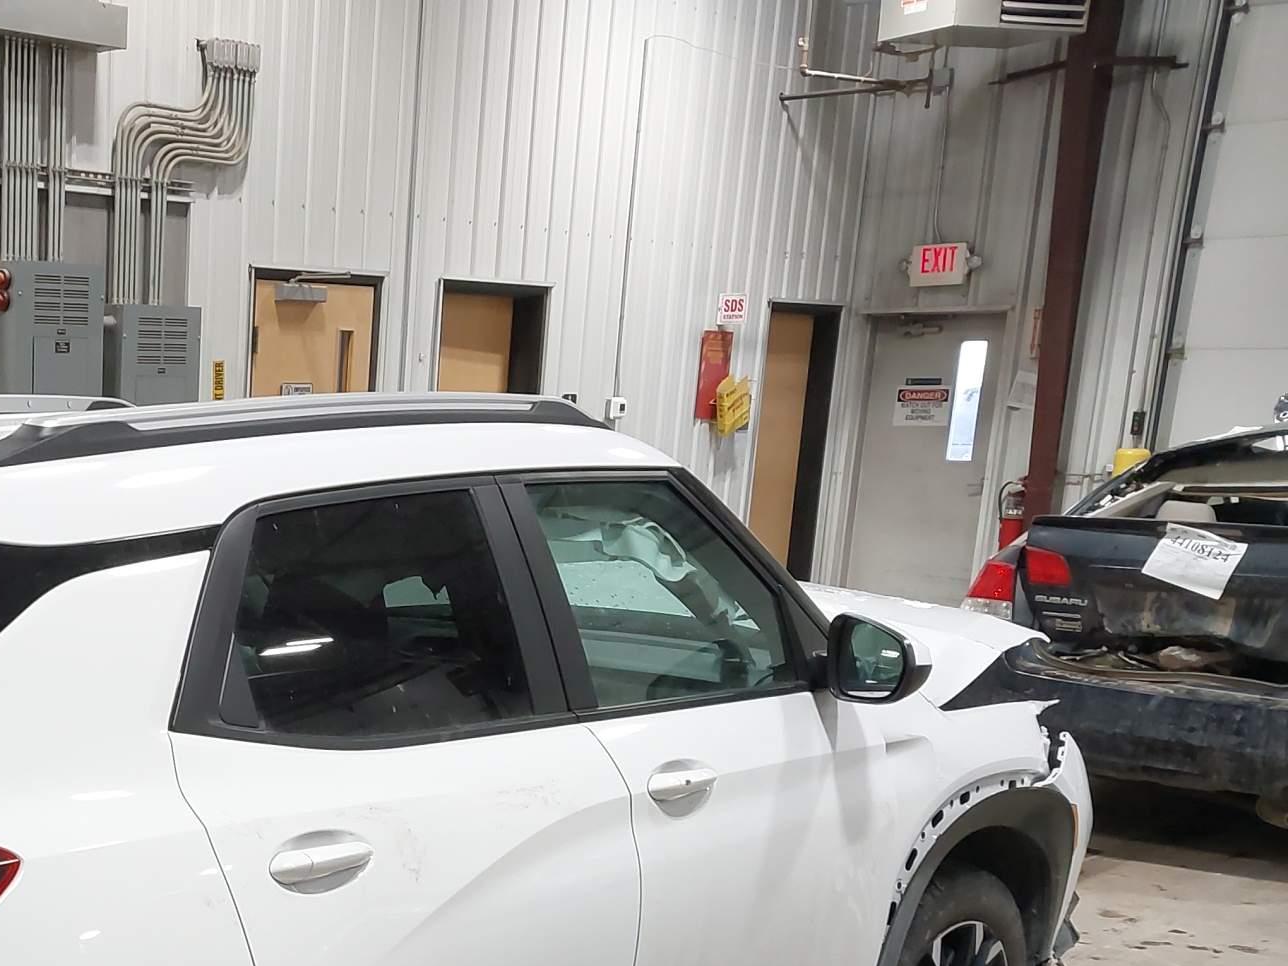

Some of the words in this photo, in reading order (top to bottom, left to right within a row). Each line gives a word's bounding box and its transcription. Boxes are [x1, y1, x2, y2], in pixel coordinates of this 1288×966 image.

[920, 246, 958, 274] EXIT
[723, 298, 744, 313] SDS
[905, 391, 942, 400] DANGER
[1035, 595, 1088, 606] SUBARU
